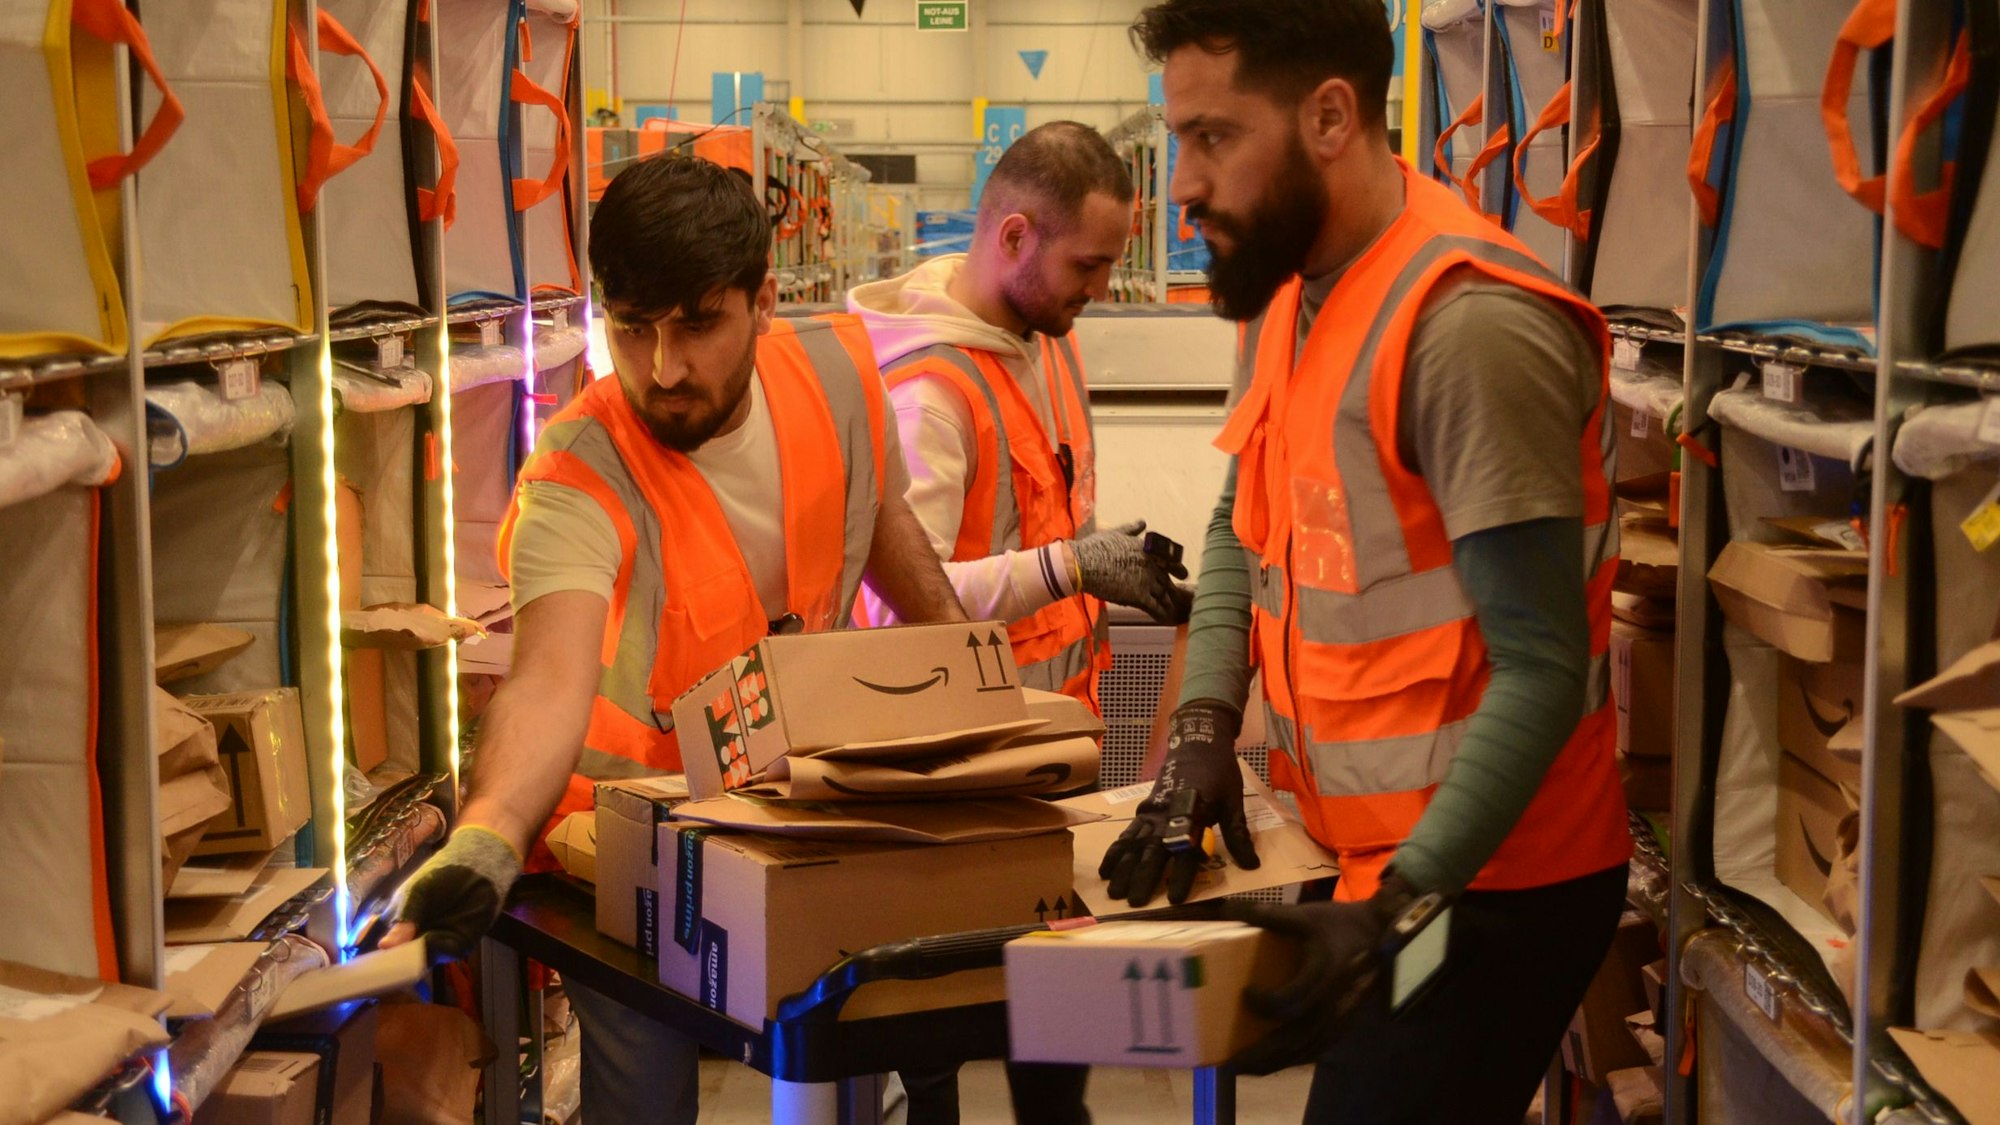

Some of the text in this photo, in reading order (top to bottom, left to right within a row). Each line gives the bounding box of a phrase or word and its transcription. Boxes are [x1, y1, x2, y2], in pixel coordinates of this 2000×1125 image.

[924, 8, 960, 16] NOT-AUS
[930, 17, 954, 25] LEINE
[1544, 36, 1553, 49] D
[987, 123, 1000, 143] C
[683, 881, 695, 940] prime
[709, 941, 719, 1010] amazon
